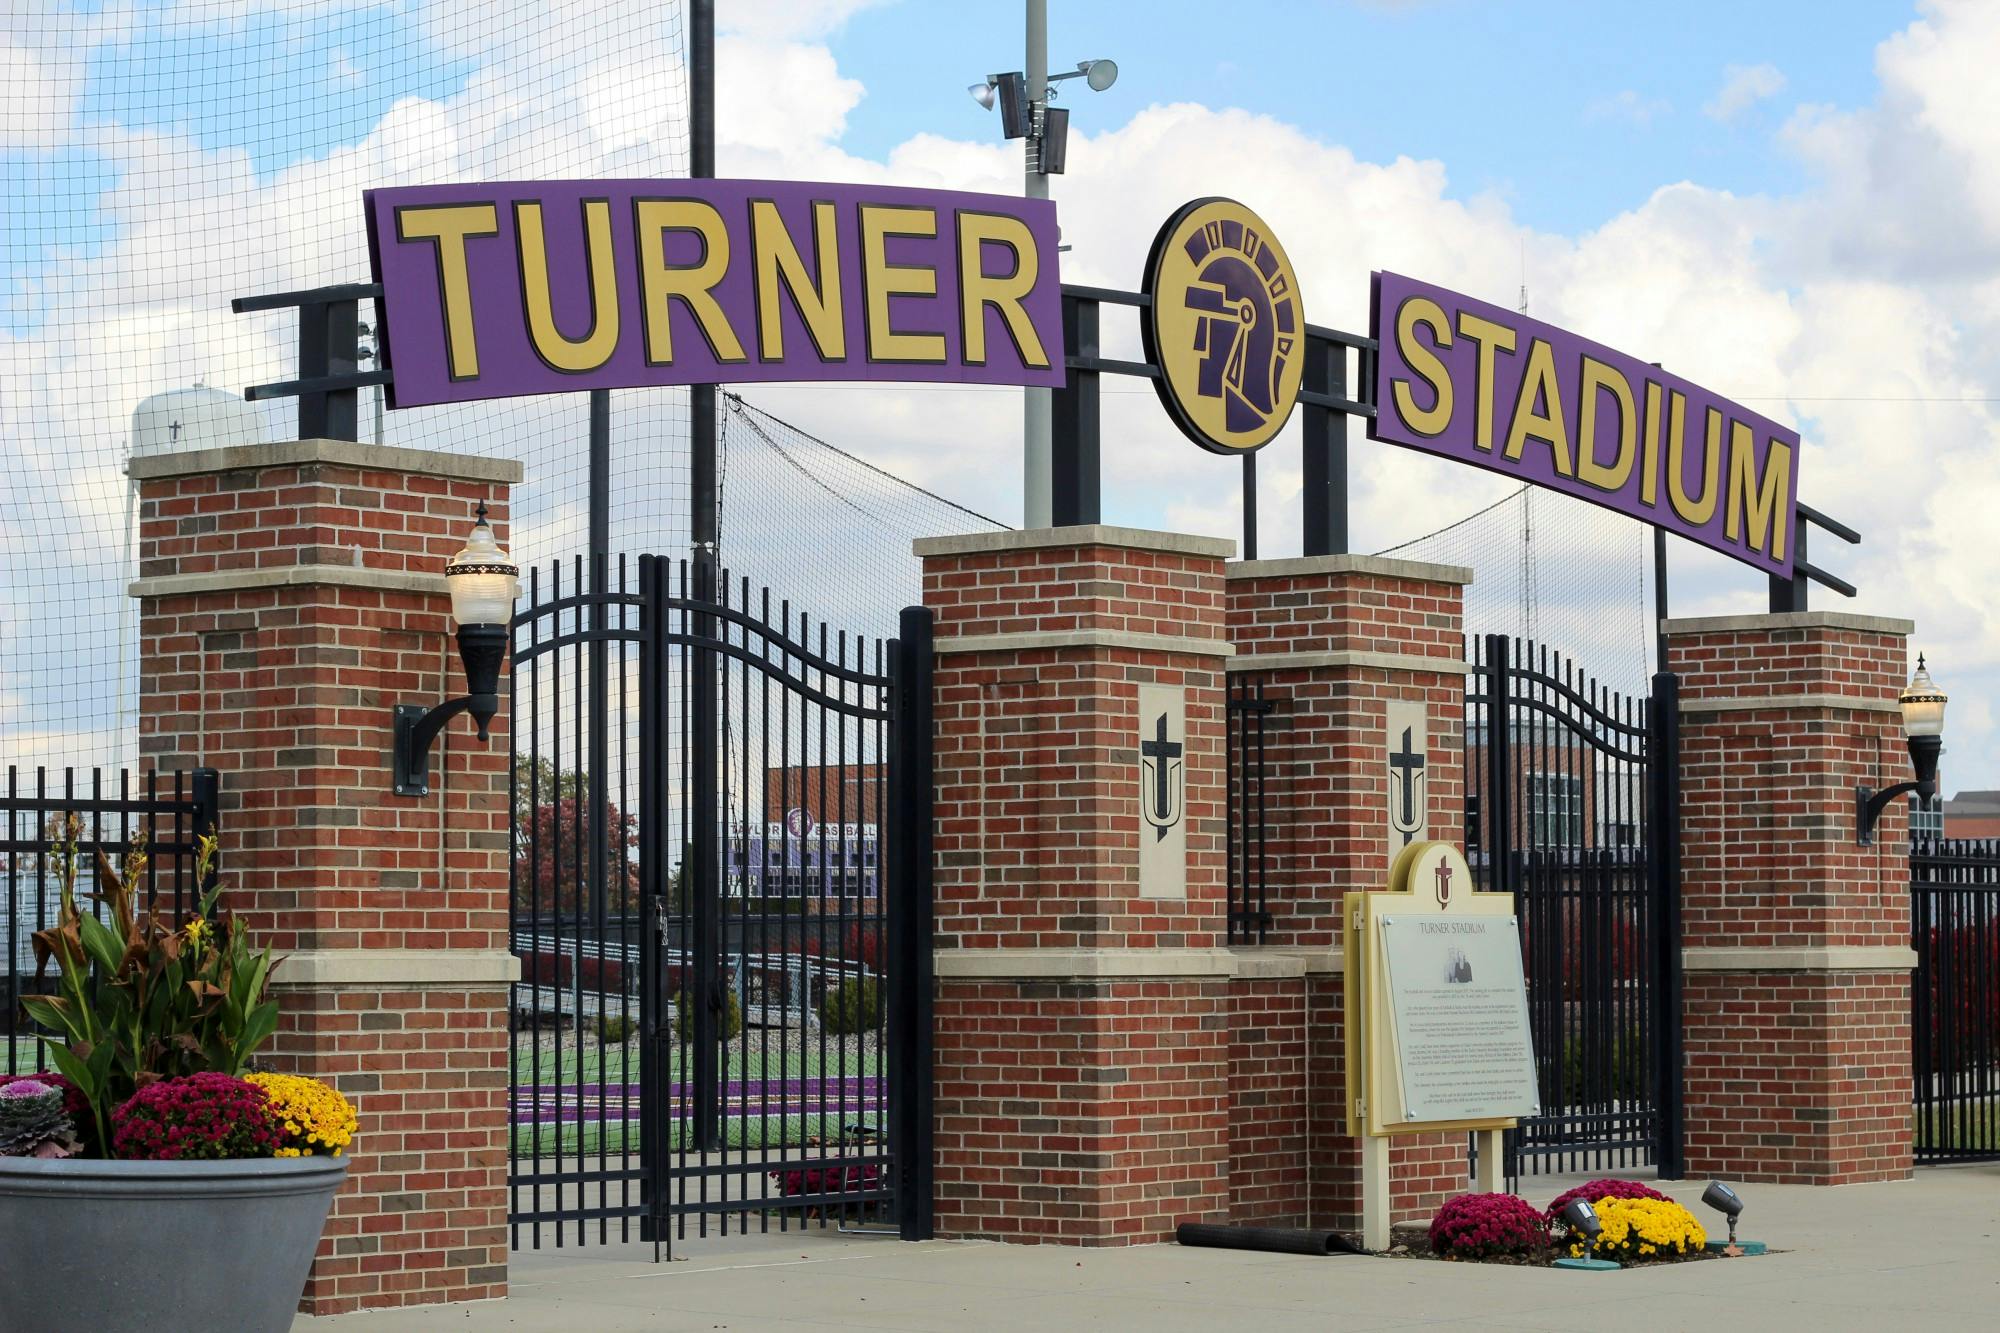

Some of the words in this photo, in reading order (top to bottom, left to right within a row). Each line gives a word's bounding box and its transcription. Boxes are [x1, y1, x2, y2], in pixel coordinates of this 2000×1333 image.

[394, 196, 1052, 382] TURNER
[1391, 295, 1793, 563] STADIUM
[1419, 922, 1450, 934] TURNER
[1452, 922, 1486, 934] STADIUM
